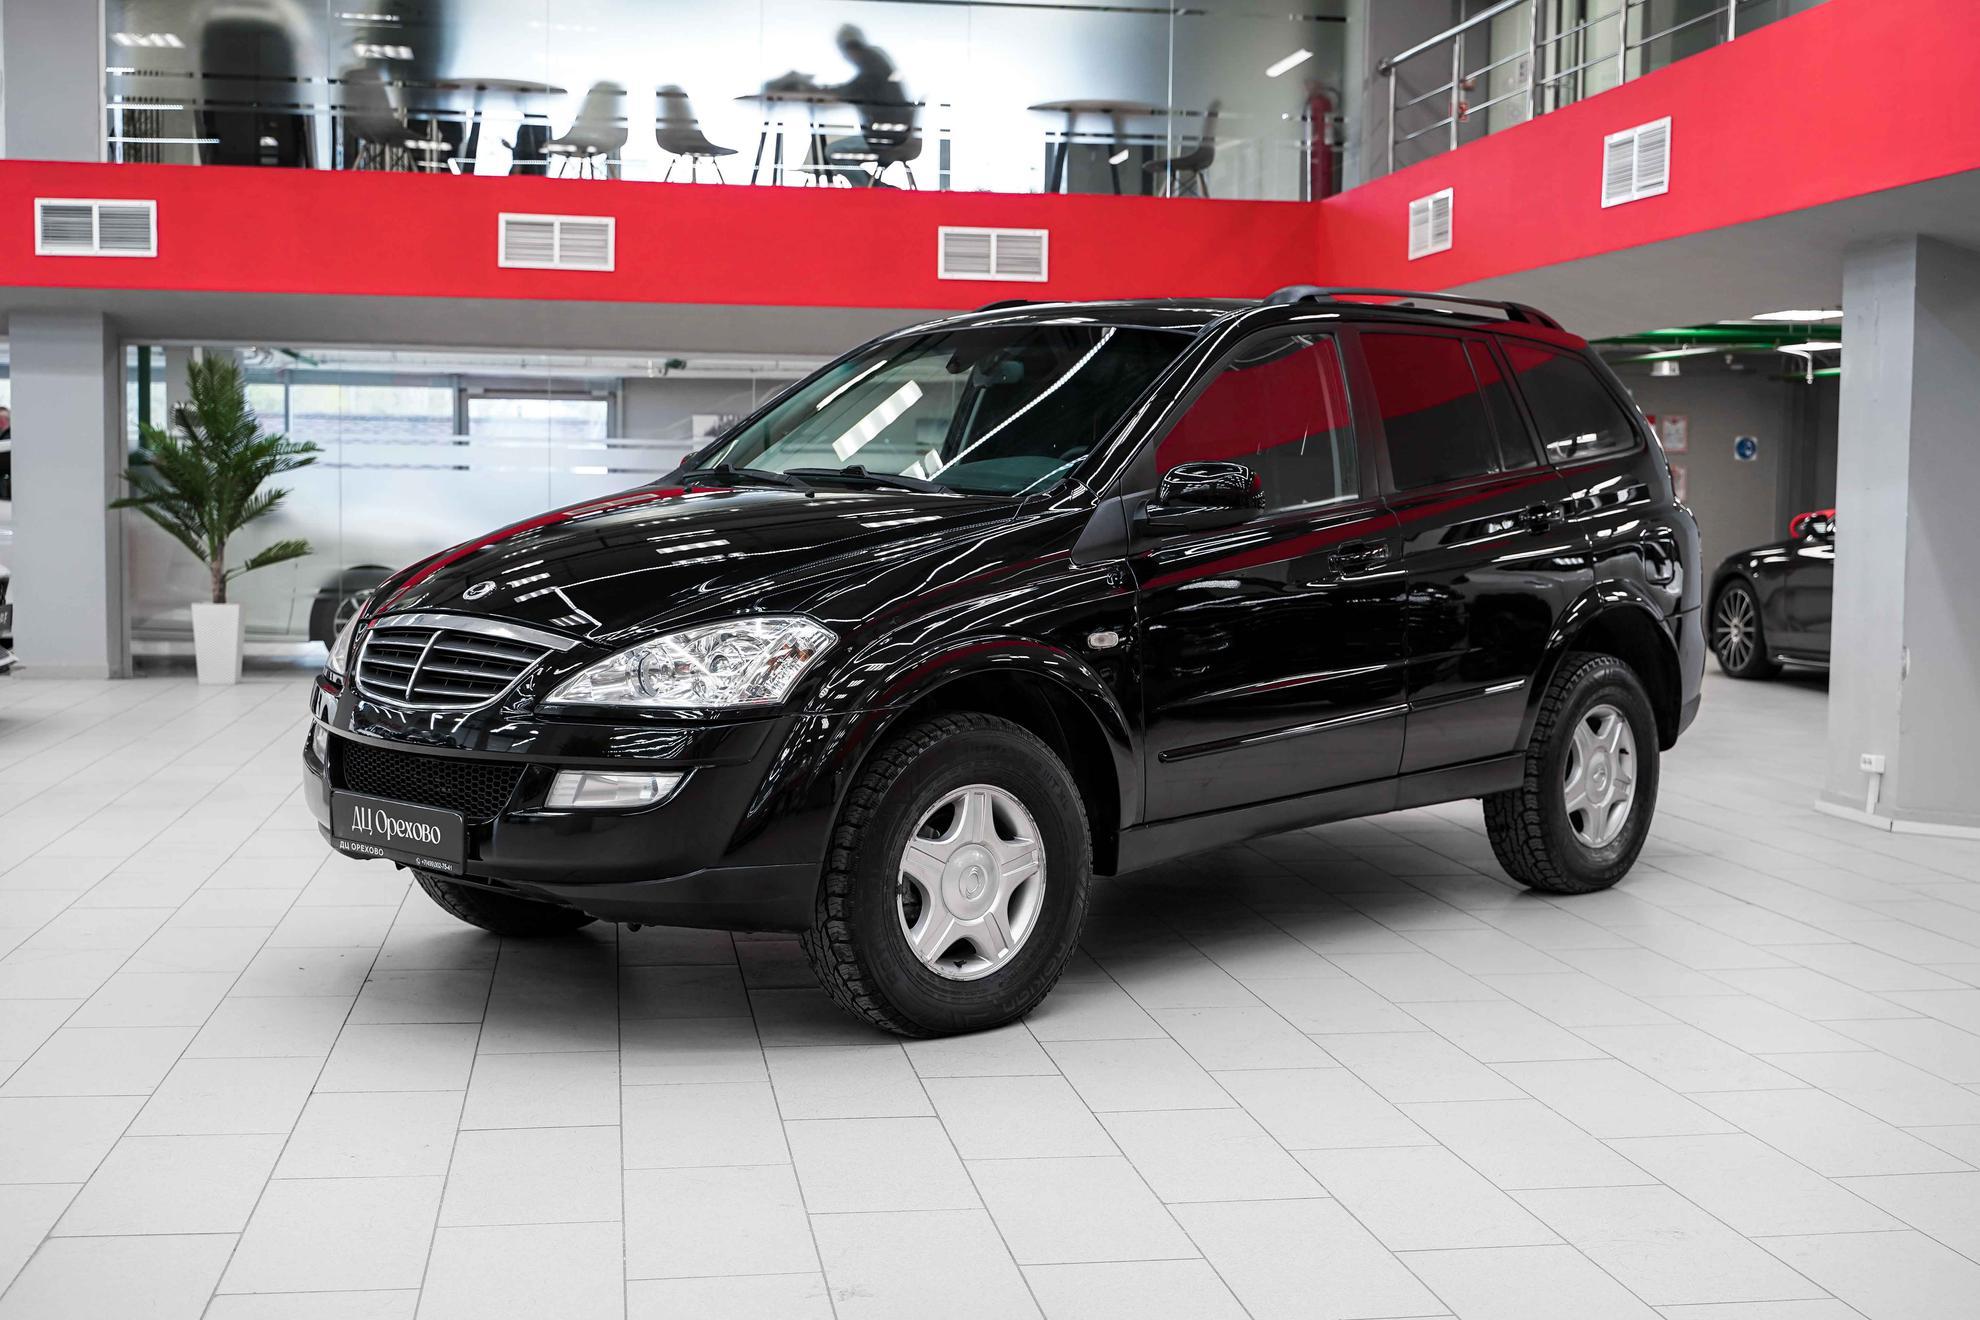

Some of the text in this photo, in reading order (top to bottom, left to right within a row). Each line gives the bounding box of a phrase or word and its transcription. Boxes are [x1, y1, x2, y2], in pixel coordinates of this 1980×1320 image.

[352, 806, 441, 845] ДЦ Орехово
[339, 840, 384, 856] ДЦ ОРЕХОВО
